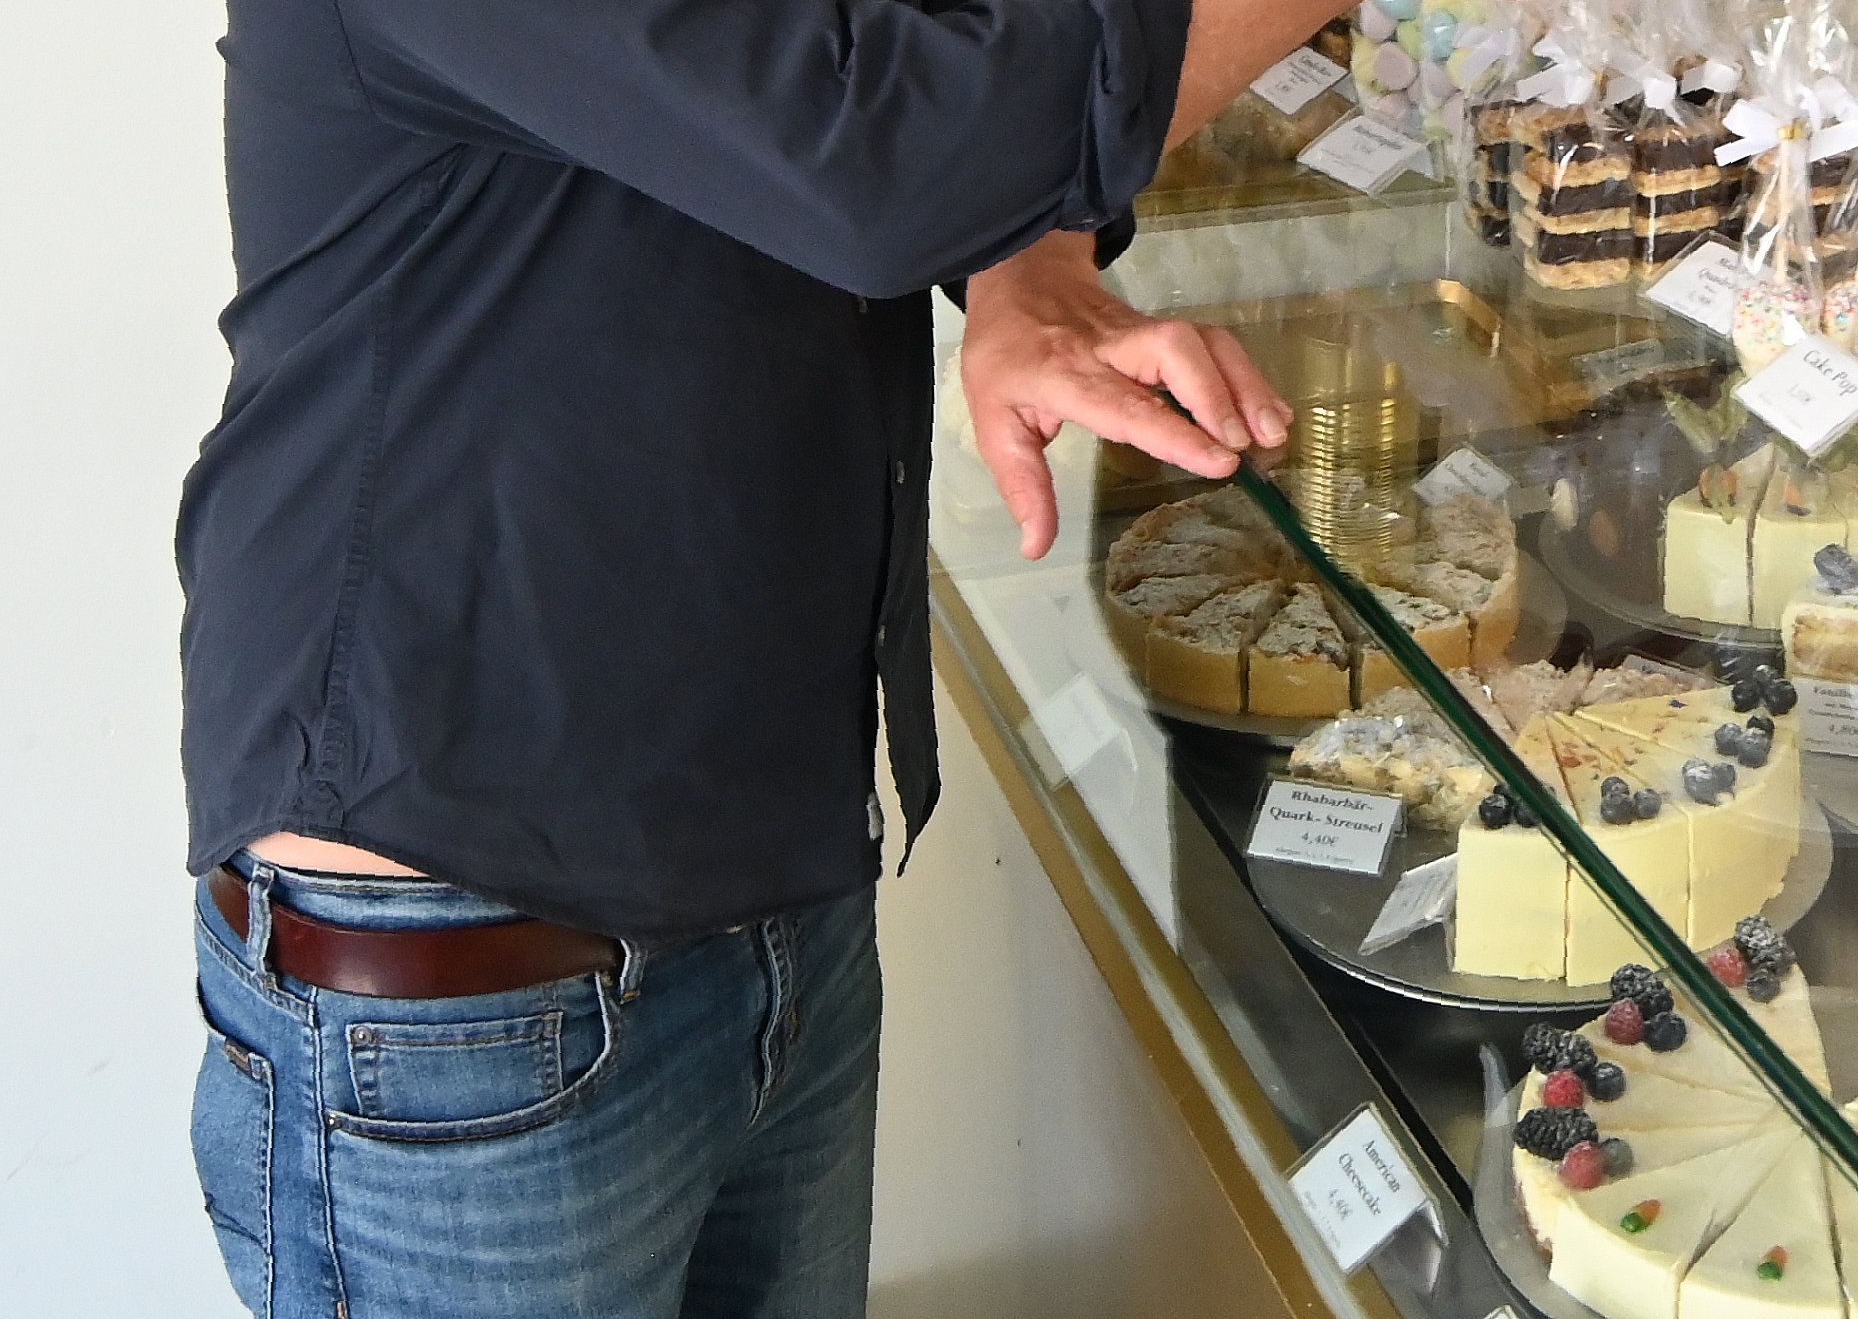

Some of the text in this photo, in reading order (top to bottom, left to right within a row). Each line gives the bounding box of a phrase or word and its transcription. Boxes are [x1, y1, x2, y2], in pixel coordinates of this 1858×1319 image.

[1803, 349, 1834, 378] Cake
[1269, 806, 1384, 834] Quark- Streusel
[1338, 1152, 1382, 1216] Cheesecake
[1362, 1139, 1401, 1193] American
